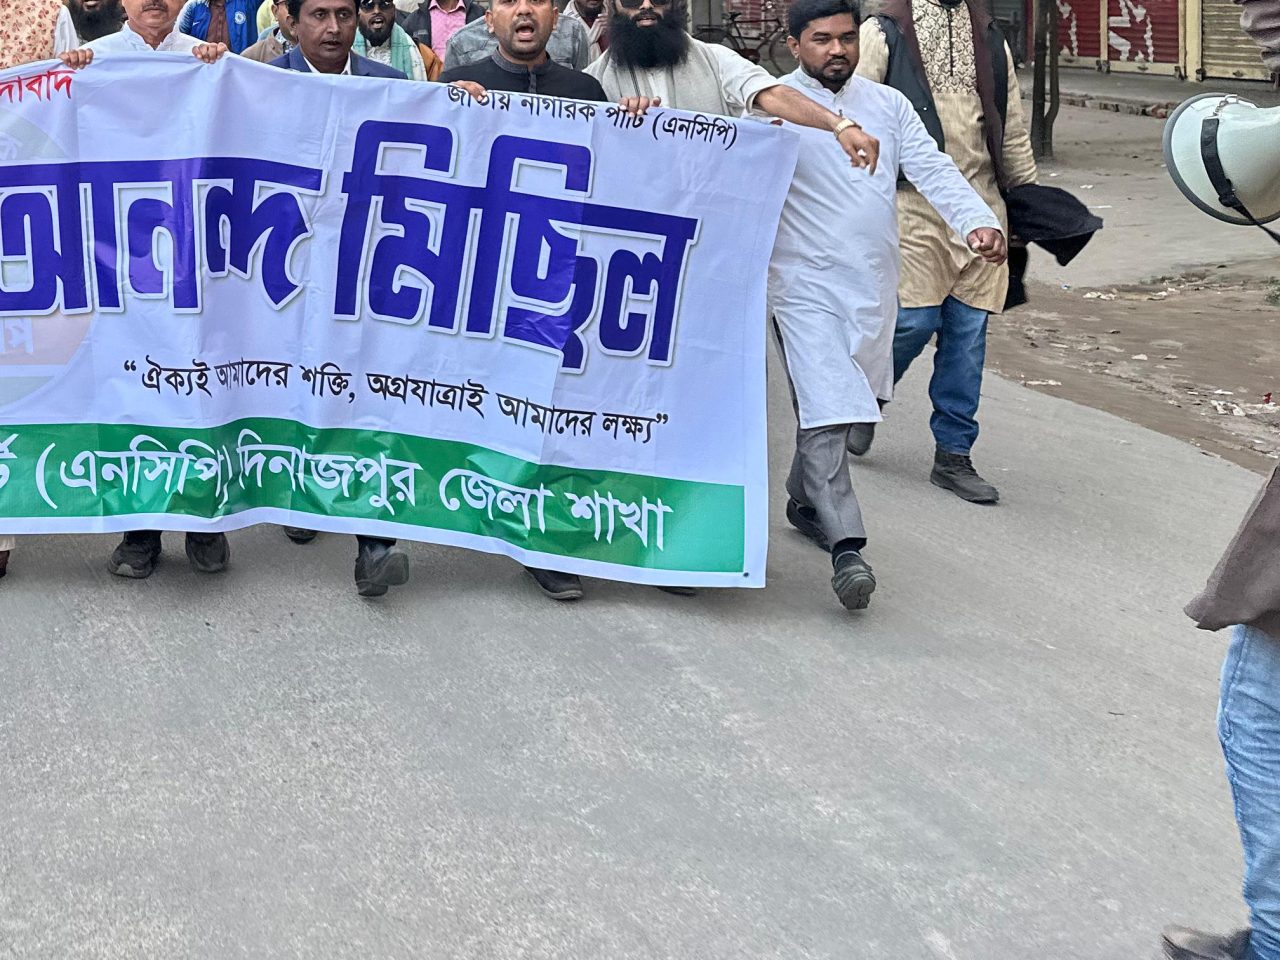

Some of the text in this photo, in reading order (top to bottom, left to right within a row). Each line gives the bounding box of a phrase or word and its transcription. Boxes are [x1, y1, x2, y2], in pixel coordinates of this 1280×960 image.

[651, 111, 738, 151] (এনসিপি)
[332, 119, 703, 375] মিছিল
[216, 360, 293, 391] আমাদের
[300, 363, 356, 406] শক্তি,
[366, 372, 489, 420] অগ্রযাত্রাই
[495, 390, 594, 440] আমাদের
[601, 410, 670, 445] লক্ষ্য”
[35, 433, 231, 510] (এনসিপি)
[235, 428, 424, 517] দিনাজপুর
[440, 466, 554, 535] জেলা
[565, 491, 675, 553] শাখা
